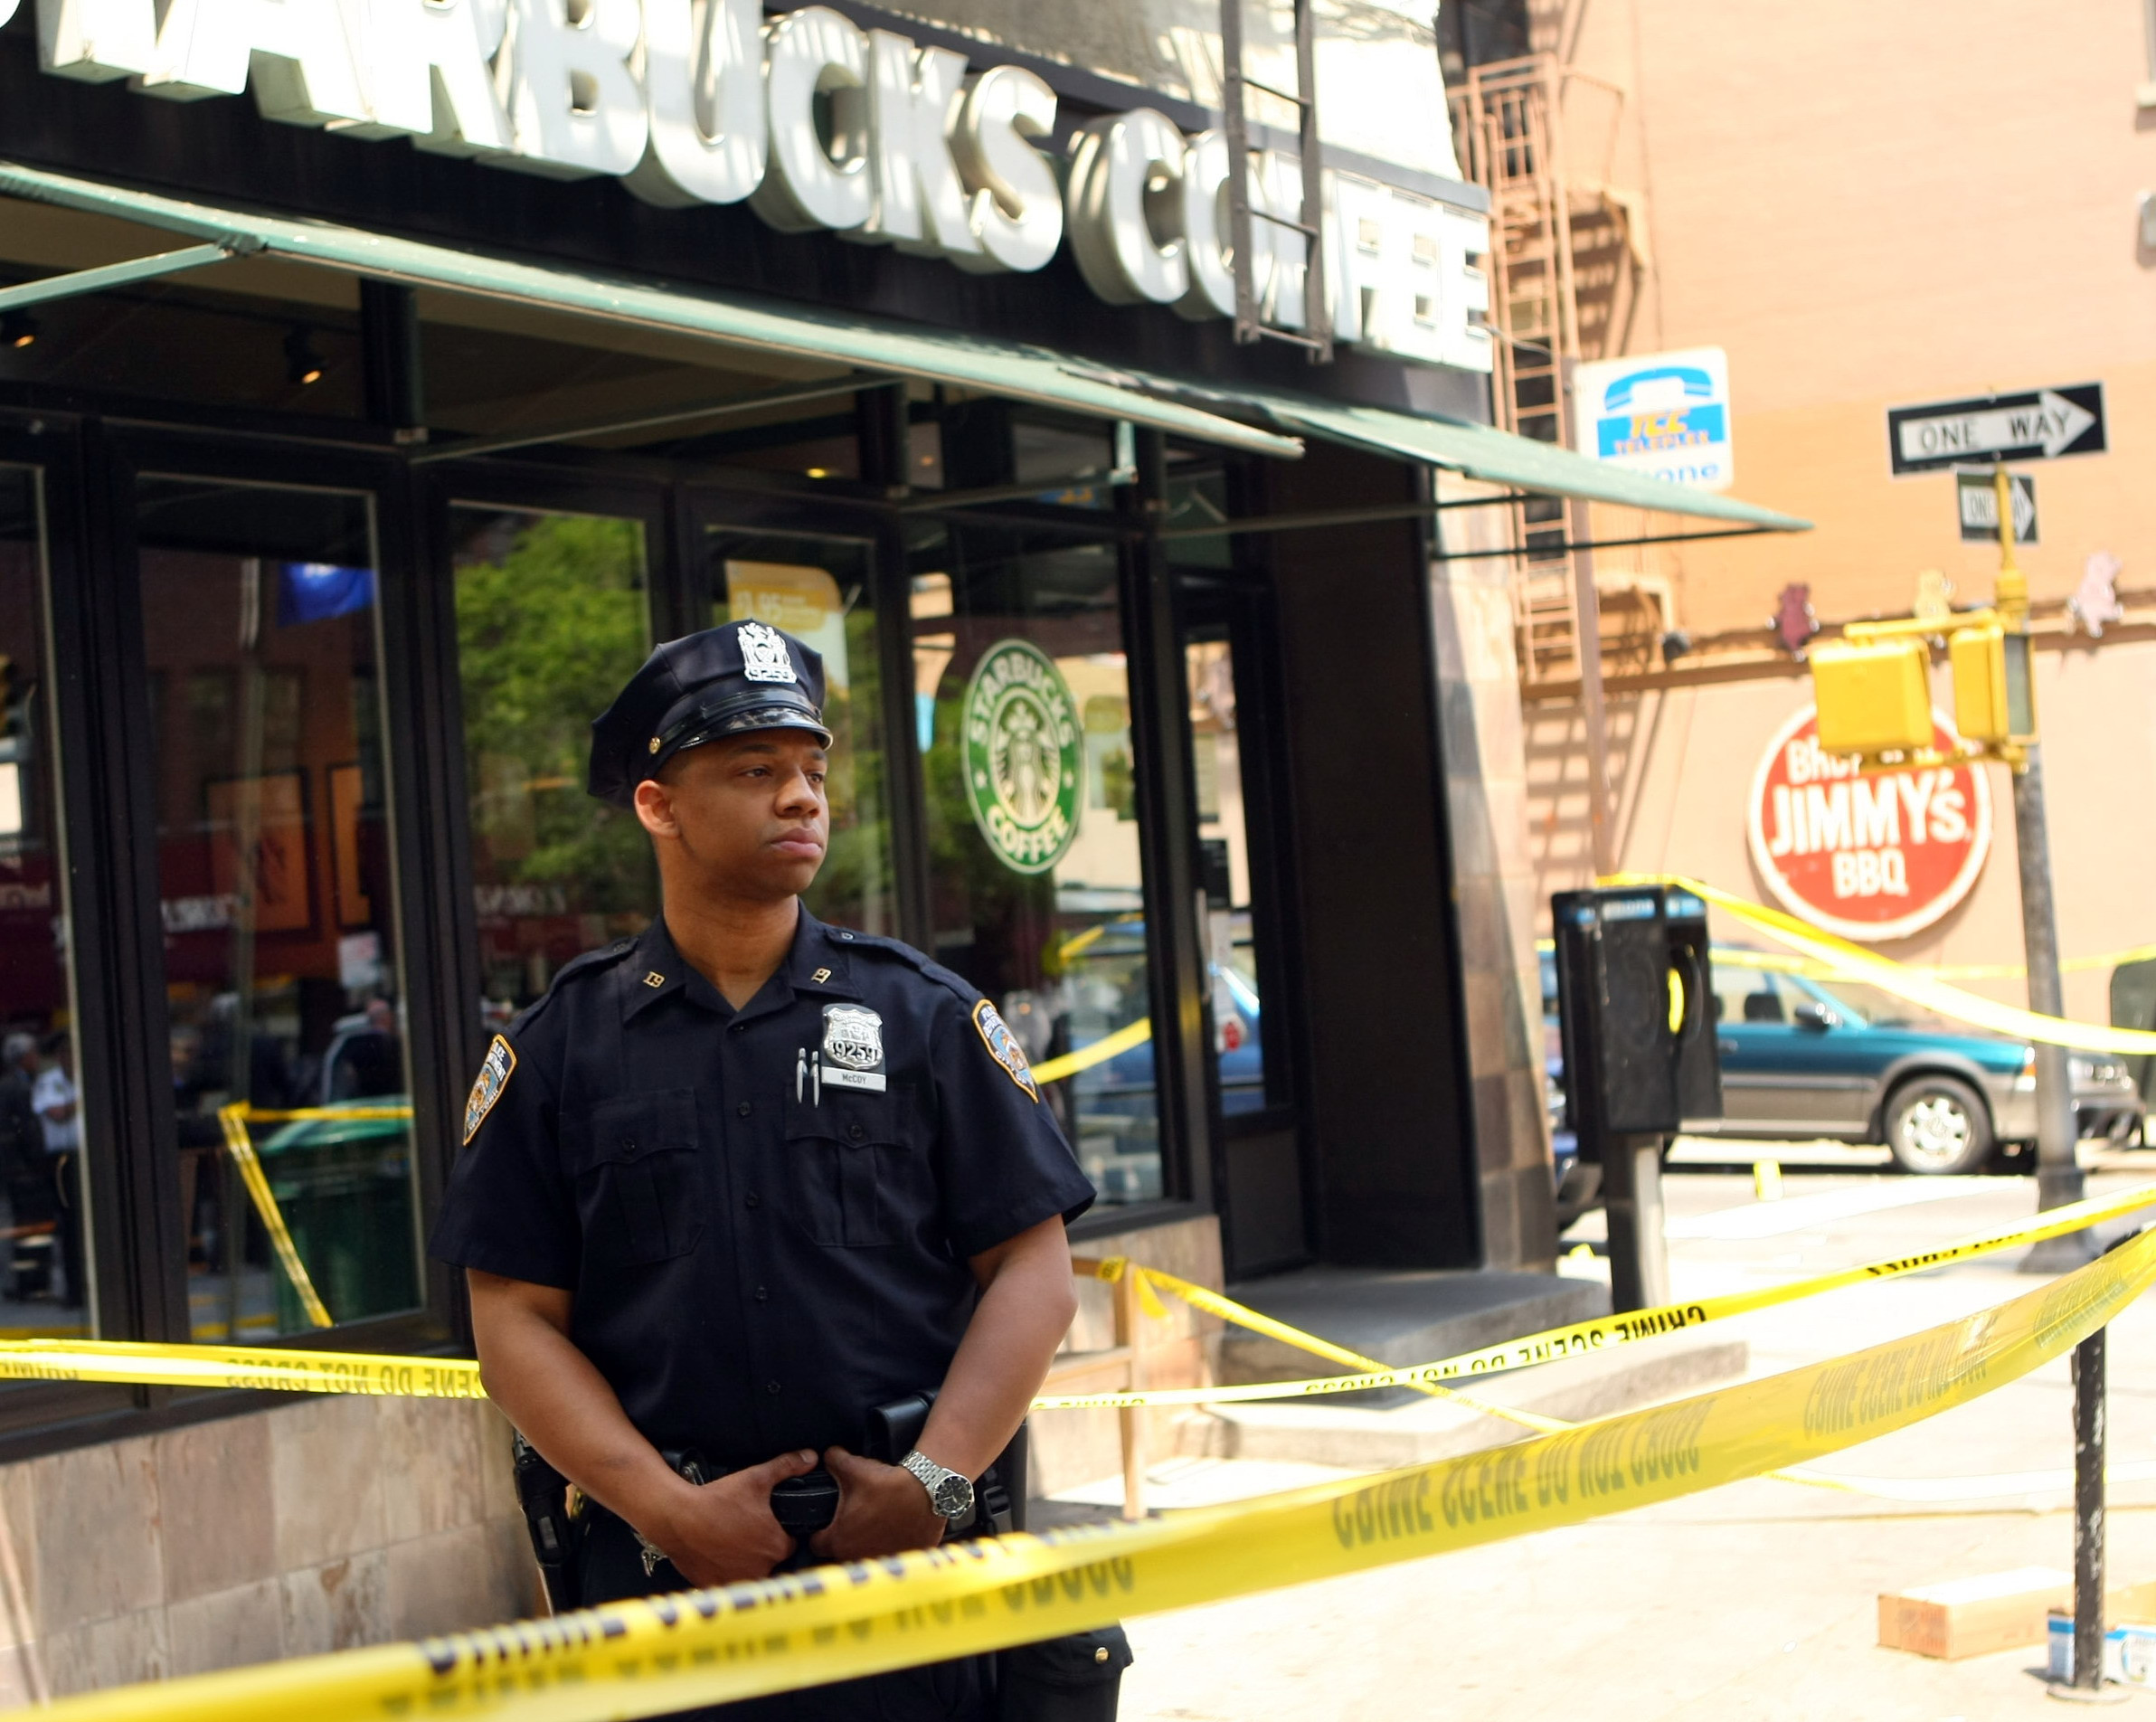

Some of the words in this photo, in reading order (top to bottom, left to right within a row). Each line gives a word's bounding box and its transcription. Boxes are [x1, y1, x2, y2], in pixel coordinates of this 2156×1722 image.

[0, 0, 1064, 273] RBUCKS
[1920, 420, 1980, 451] ONE
[2009, 409, 2072, 444] WAY
[970, 651, 1075, 748] STARBUCKS
[987, 804, 1070, 865] COFFEE
[1831, 847, 1909, 899] BBQ
[833, 1040, 878, 1064] 9259
[842, 1073, 867, 1084] McCOY
